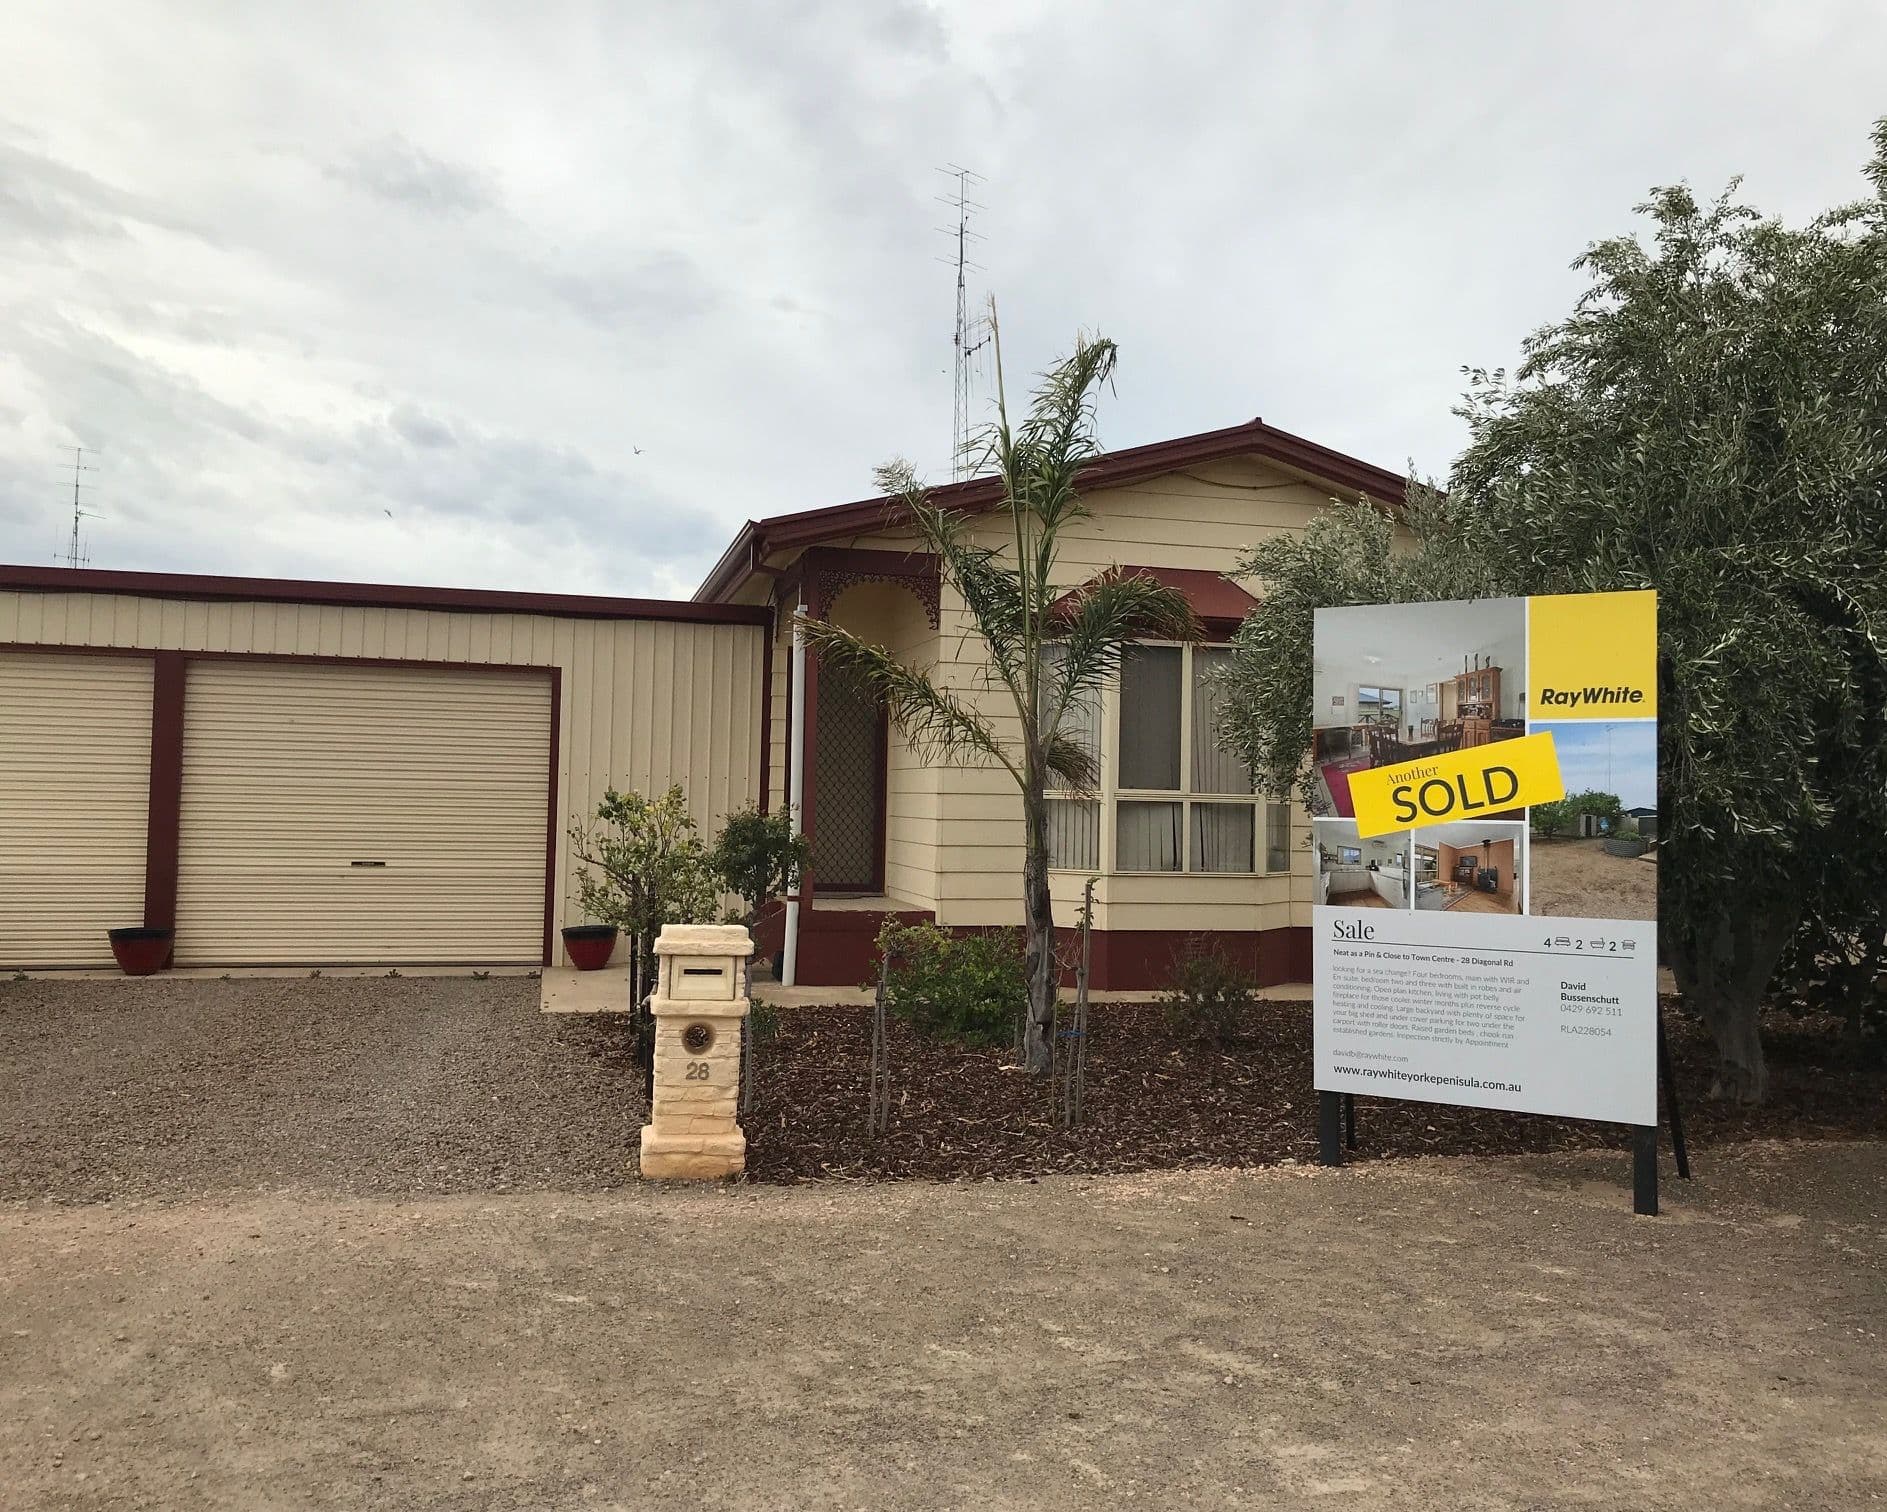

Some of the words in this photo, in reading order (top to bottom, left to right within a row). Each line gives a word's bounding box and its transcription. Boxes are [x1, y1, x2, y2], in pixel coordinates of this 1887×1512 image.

[1387, 766, 1439, 785] Another
[1392, 766, 1518, 822] SOLD
[1334, 920, 1374, 940] Sale
[1544, 938, 1551, 947] 4
[1576, 940, 1583, 949] 2
[1609, 942, 1616, 951] 2
[1432, 955, 1454, 963] Centre
[1472, 958, 1502, 966] Diagonal
[1560, 981, 1586, 991] David
[1560, 993, 1620, 1004] Bussenschutt
[1560, 1004, 1583, 1013] 0429
[1586, 1006, 1602, 1015] 692
[1606, 1007, 1621, 1016] 511
[1560, 1025, 1611, 1036] RLA228054
[1333, 1049, 1408, 1063] davidb@raywhite.com
[686, 1062, 710, 1080] 28
[1333, 1064, 1522, 1093] www.raywhiteyorkepenisula.com.au
